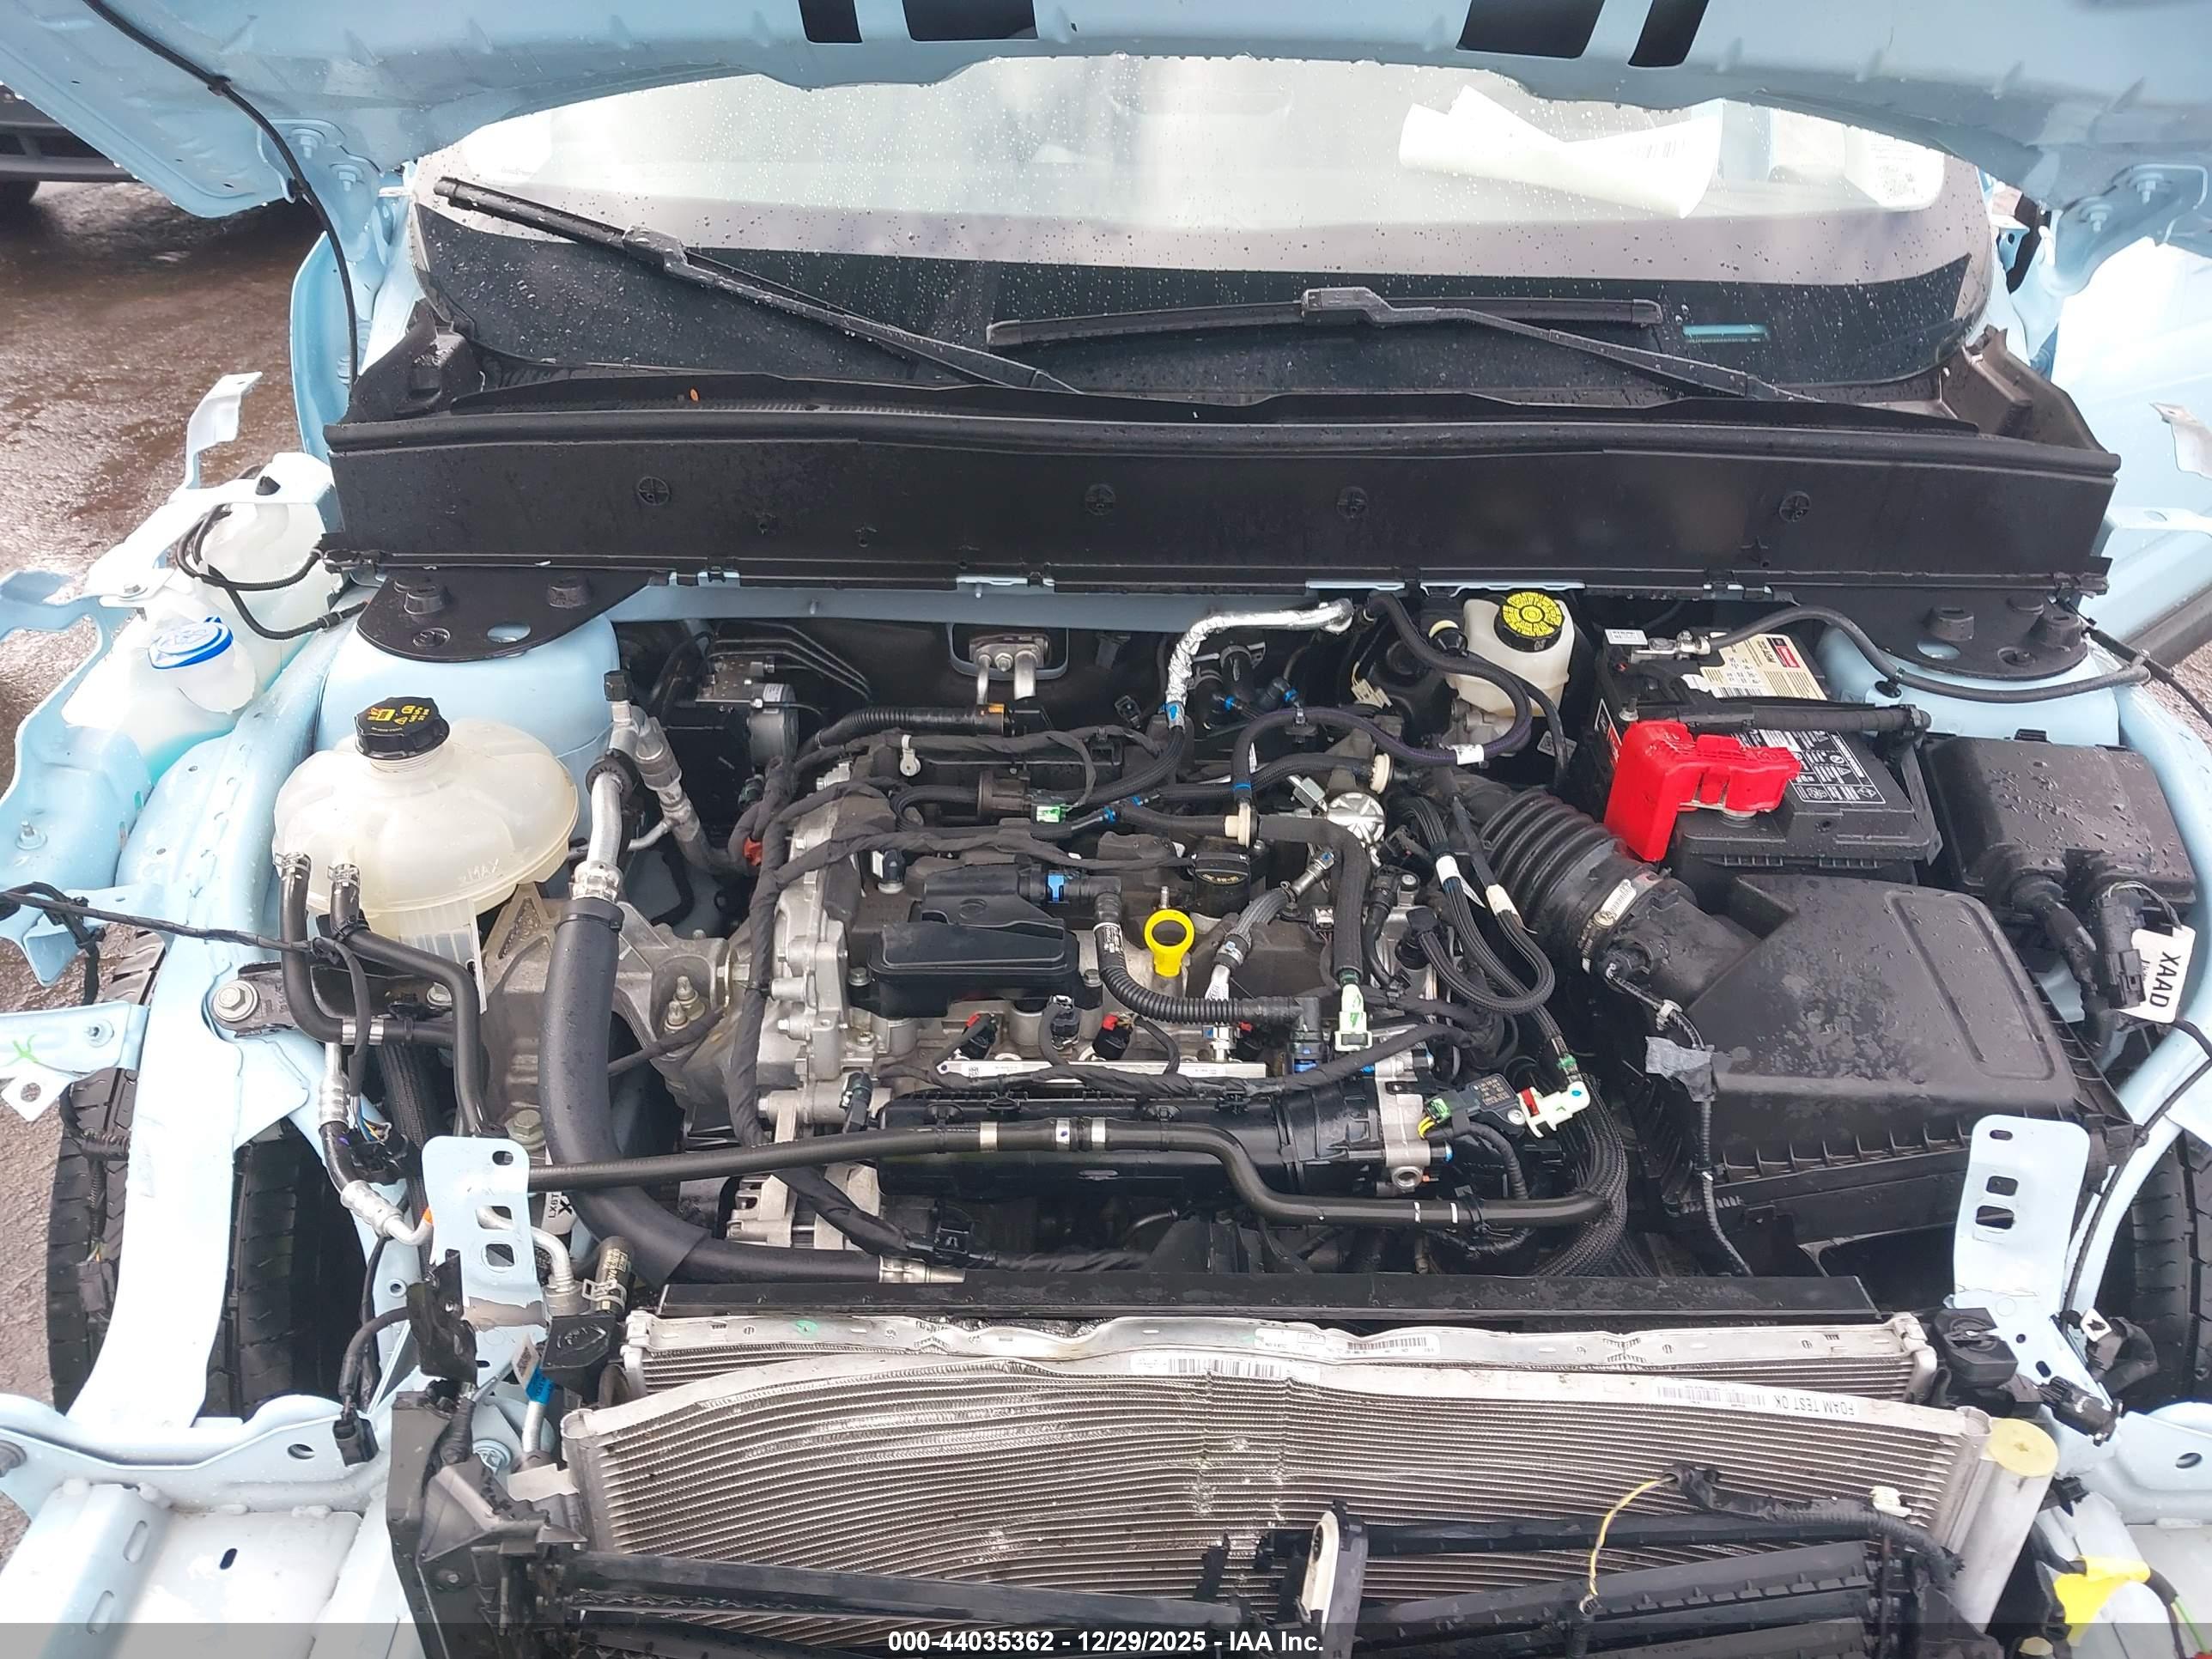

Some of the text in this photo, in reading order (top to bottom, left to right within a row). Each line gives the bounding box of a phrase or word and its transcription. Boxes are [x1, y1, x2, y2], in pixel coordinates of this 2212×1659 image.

[2149, 951, 2181, 1008] XAAD
[1773, 1395, 1855, 1416] FOAM TEST OK
